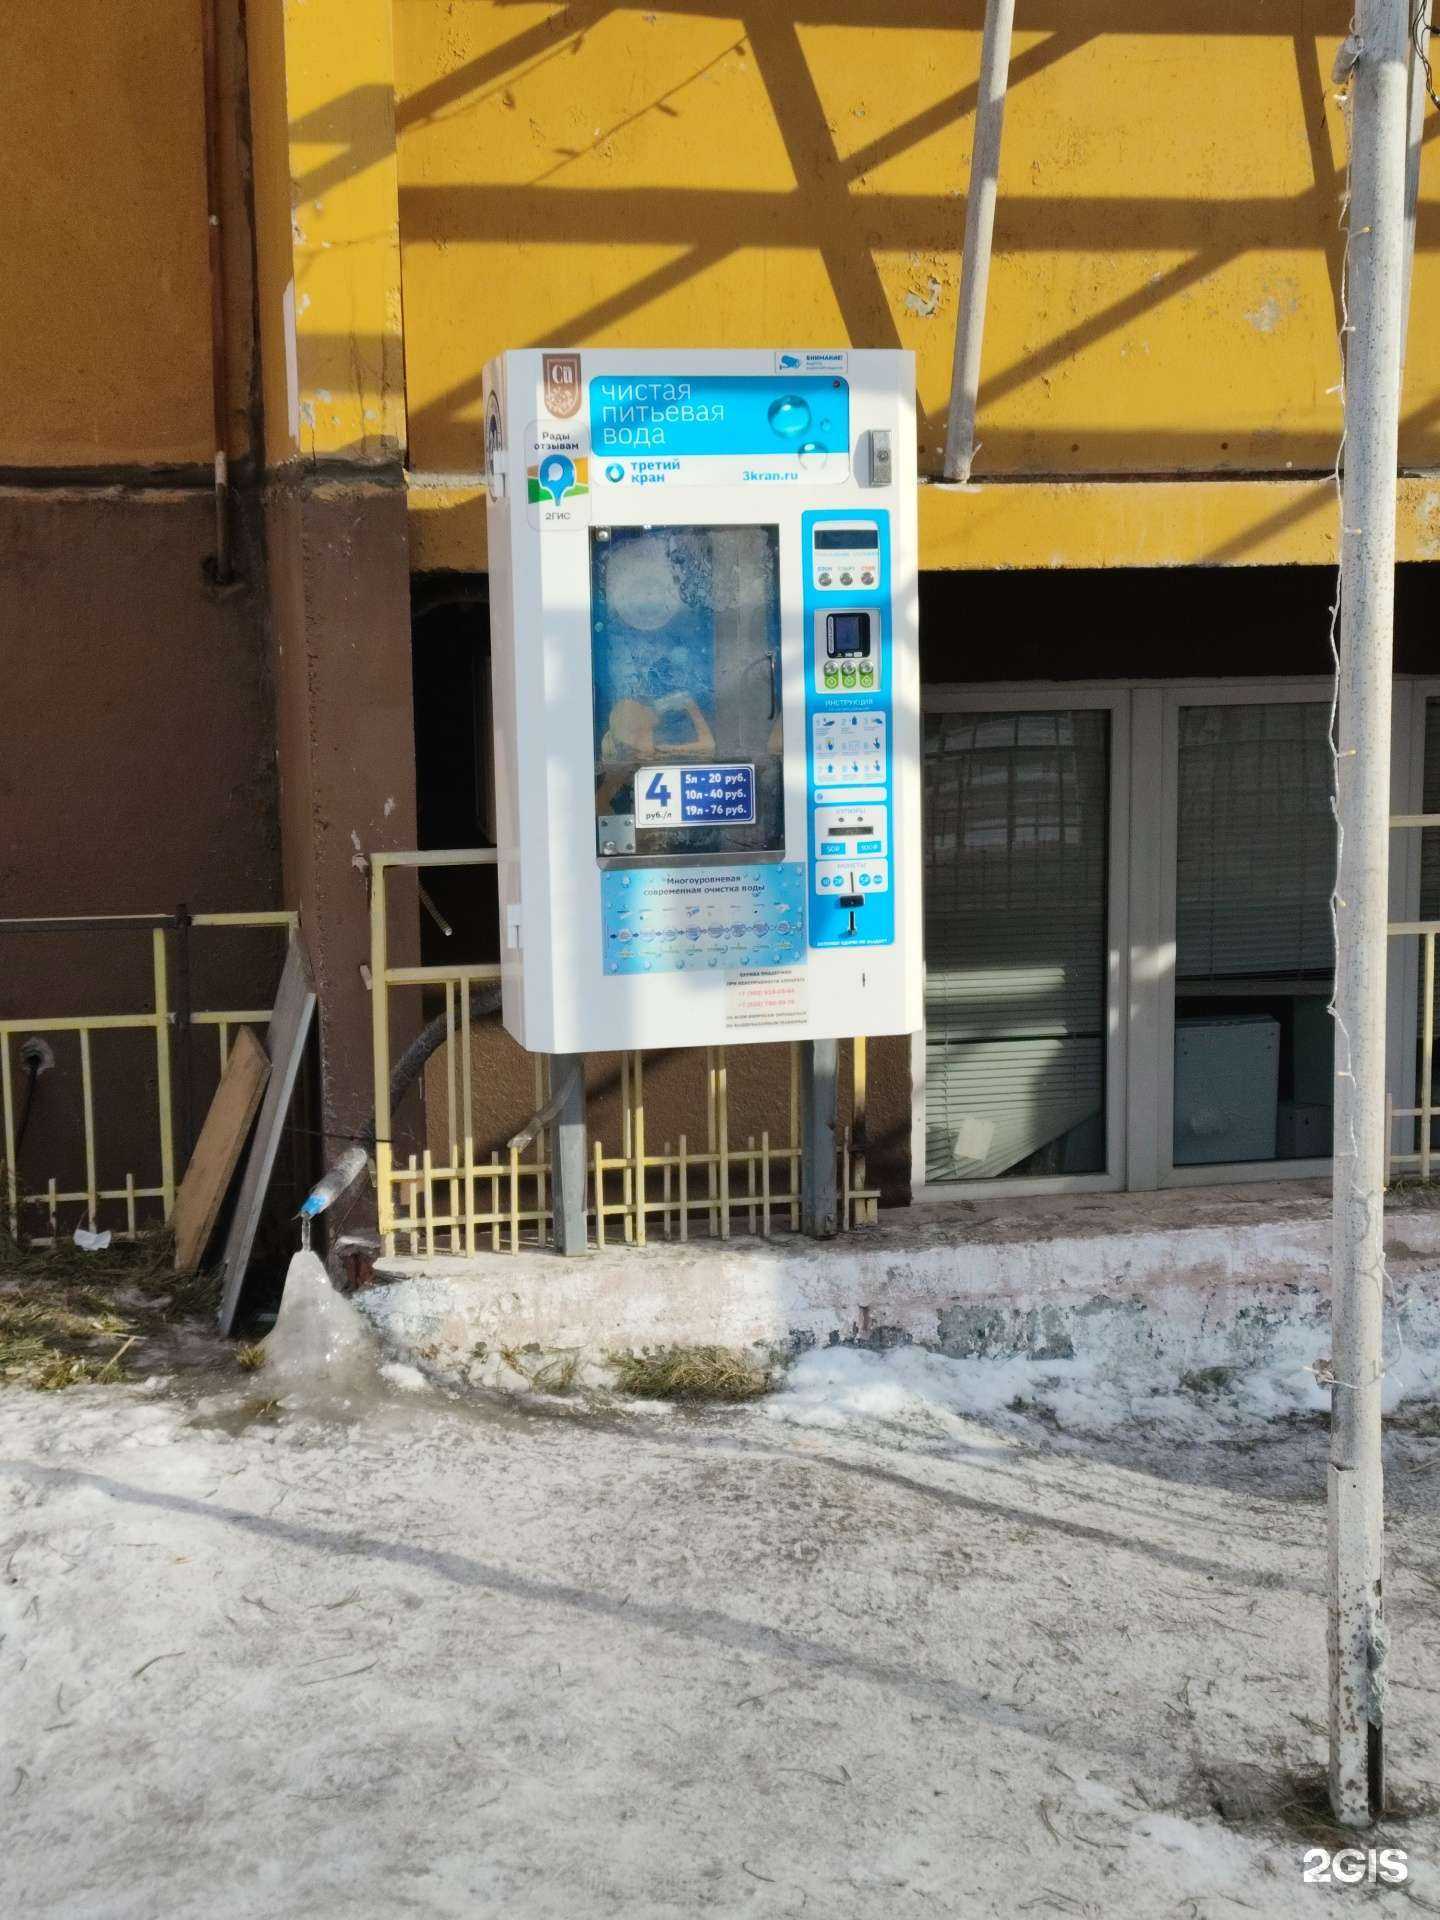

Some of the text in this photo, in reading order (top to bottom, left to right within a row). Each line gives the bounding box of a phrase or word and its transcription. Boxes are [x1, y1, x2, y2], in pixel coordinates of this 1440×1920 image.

[601, 383, 691, 401] чистая
[603, 404, 725, 423] питьевая
[542, 432, 570, 442] Рады
[603, 427, 666, 448] вода
[534, 443, 579, 451] отзывам
[631, 458, 681, 472] третий
[632, 474, 665, 485] кран
[743, 471, 799, 481] 3kran.ru
[545, 512, 571, 521] 2ГИС
[685, 774, 698, 784] 5л
[708, 773, 721, 783] 20
[725, 772, 747, 785] руб.
[645, 772, 672, 807] 4
[685, 789, 703, 800] 10л
[710, 789, 723, 799] 40
[725, 788, 747, 800] руб.
[646, 811, 672, 819] руб./л
[685, 805, 704, 816] 19л
[711, 804, 724, 815] 76
[725, 803, 747, 816] руб.
[667, 875, 741, 885] Многоуровневая
[643, 884, 765, 897] современная очистка воды
